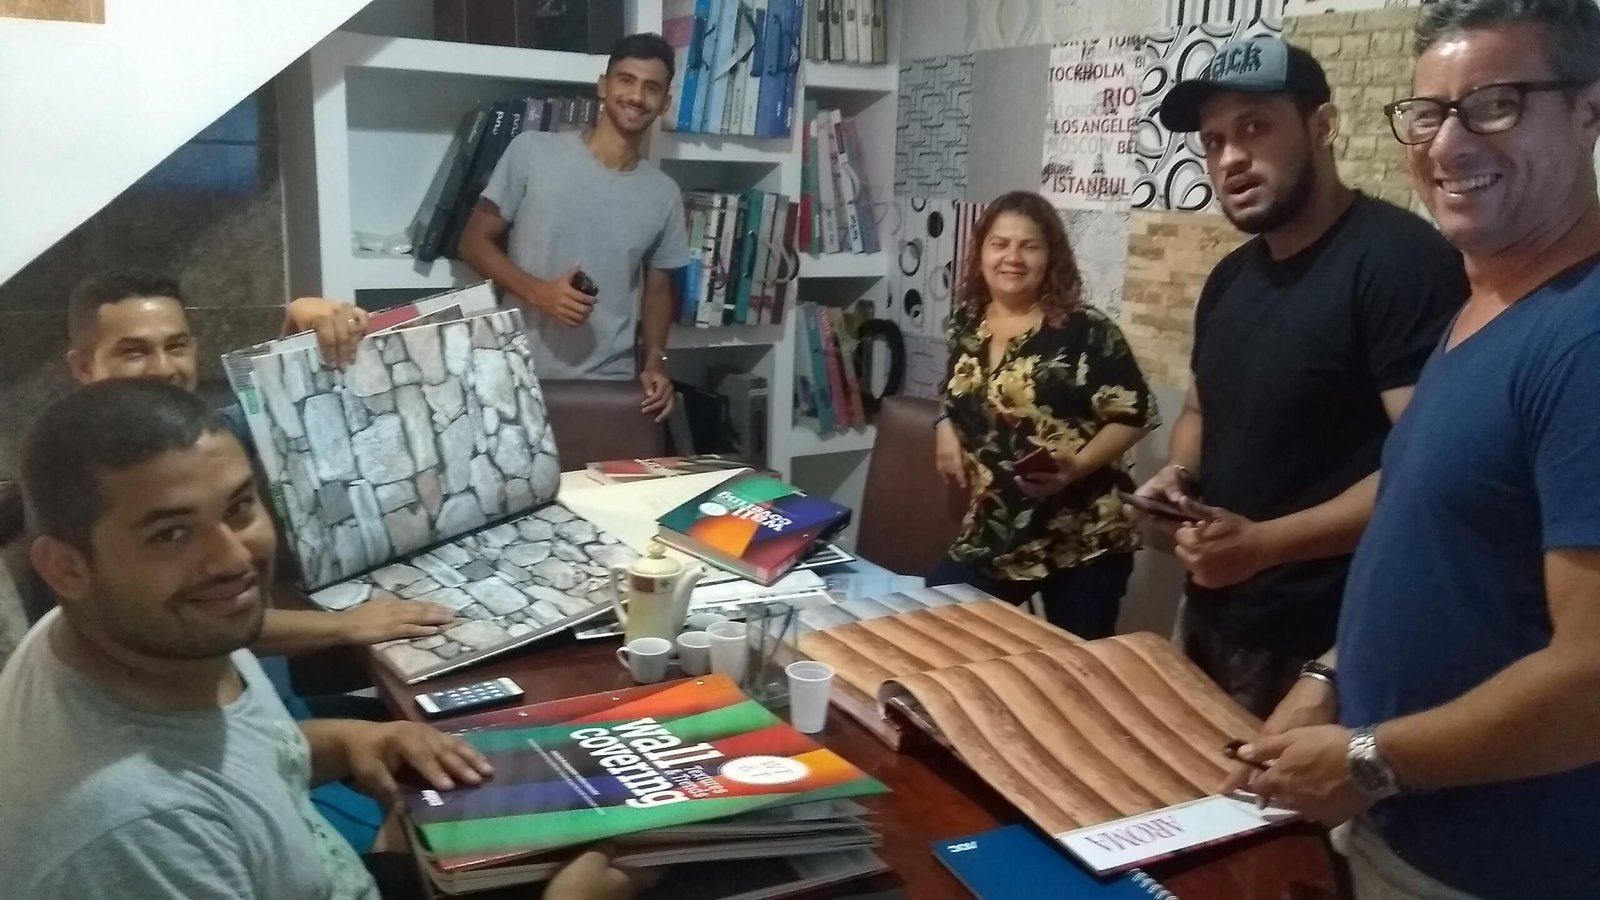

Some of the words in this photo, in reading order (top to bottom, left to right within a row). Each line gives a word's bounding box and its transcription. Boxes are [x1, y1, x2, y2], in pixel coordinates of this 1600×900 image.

[1103, 86, 1137, 107] RIO
[1054, 119, 1078, 134] LOS
[1053, 177, 1129, 196] ISTANBUL
[611, 717, 725, 769] wall
[569, 727, 690, 809] covering
[1084, 815, 1185, 851] AROMA
